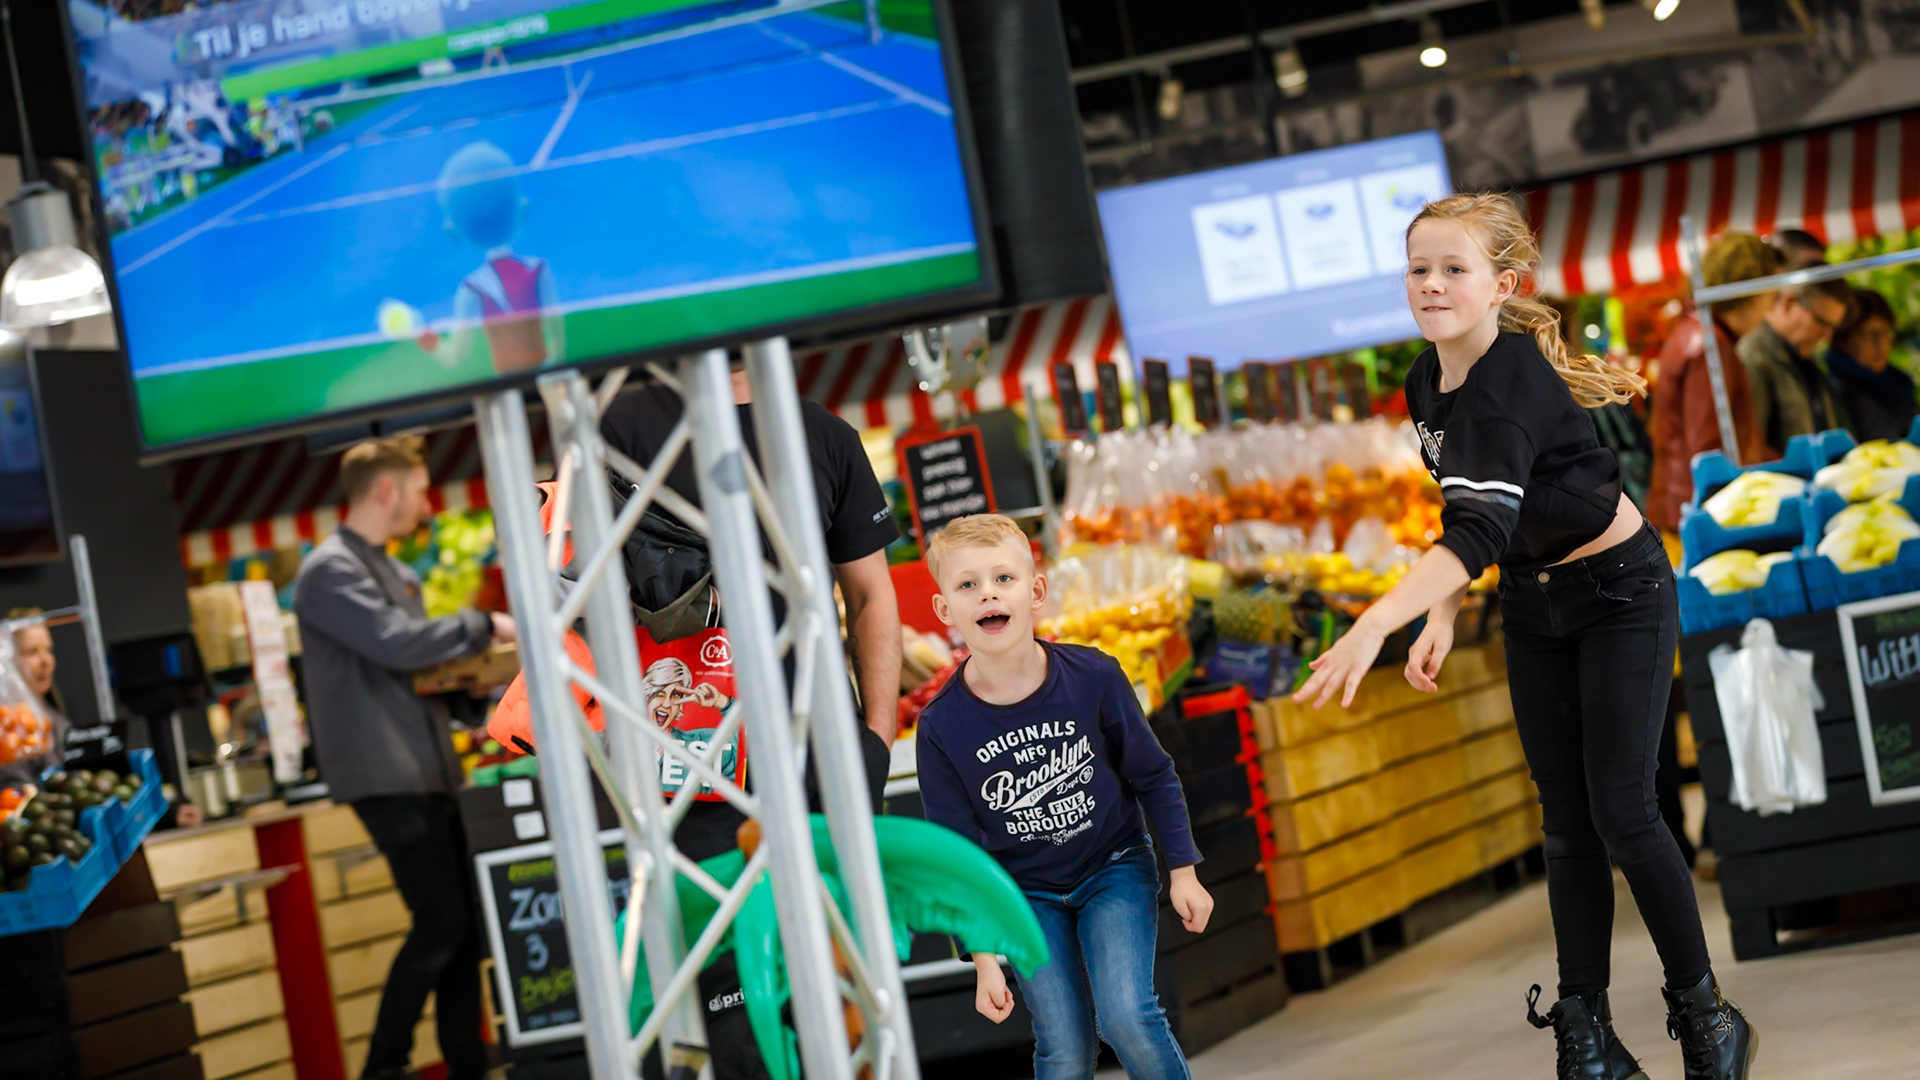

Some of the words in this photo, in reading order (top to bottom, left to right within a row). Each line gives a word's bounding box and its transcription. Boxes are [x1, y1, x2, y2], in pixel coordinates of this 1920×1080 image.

[193, 25, 232, 59] Til
[236, 20, 268, 59] je
[272, 4, 350, 43] hand
[976, 720, 1076, 764] ORIGINALS
[1013, 744, 1047, 765] MFG
[981, 735, 1092, 811] Brooklyn
[1005, 796, 1096, 835] BOROUGHS
[1012, 807, 1046, 821] THE
[1053, 793, 1084, 813] FIVE
[525, 933, 549, 971] 3
